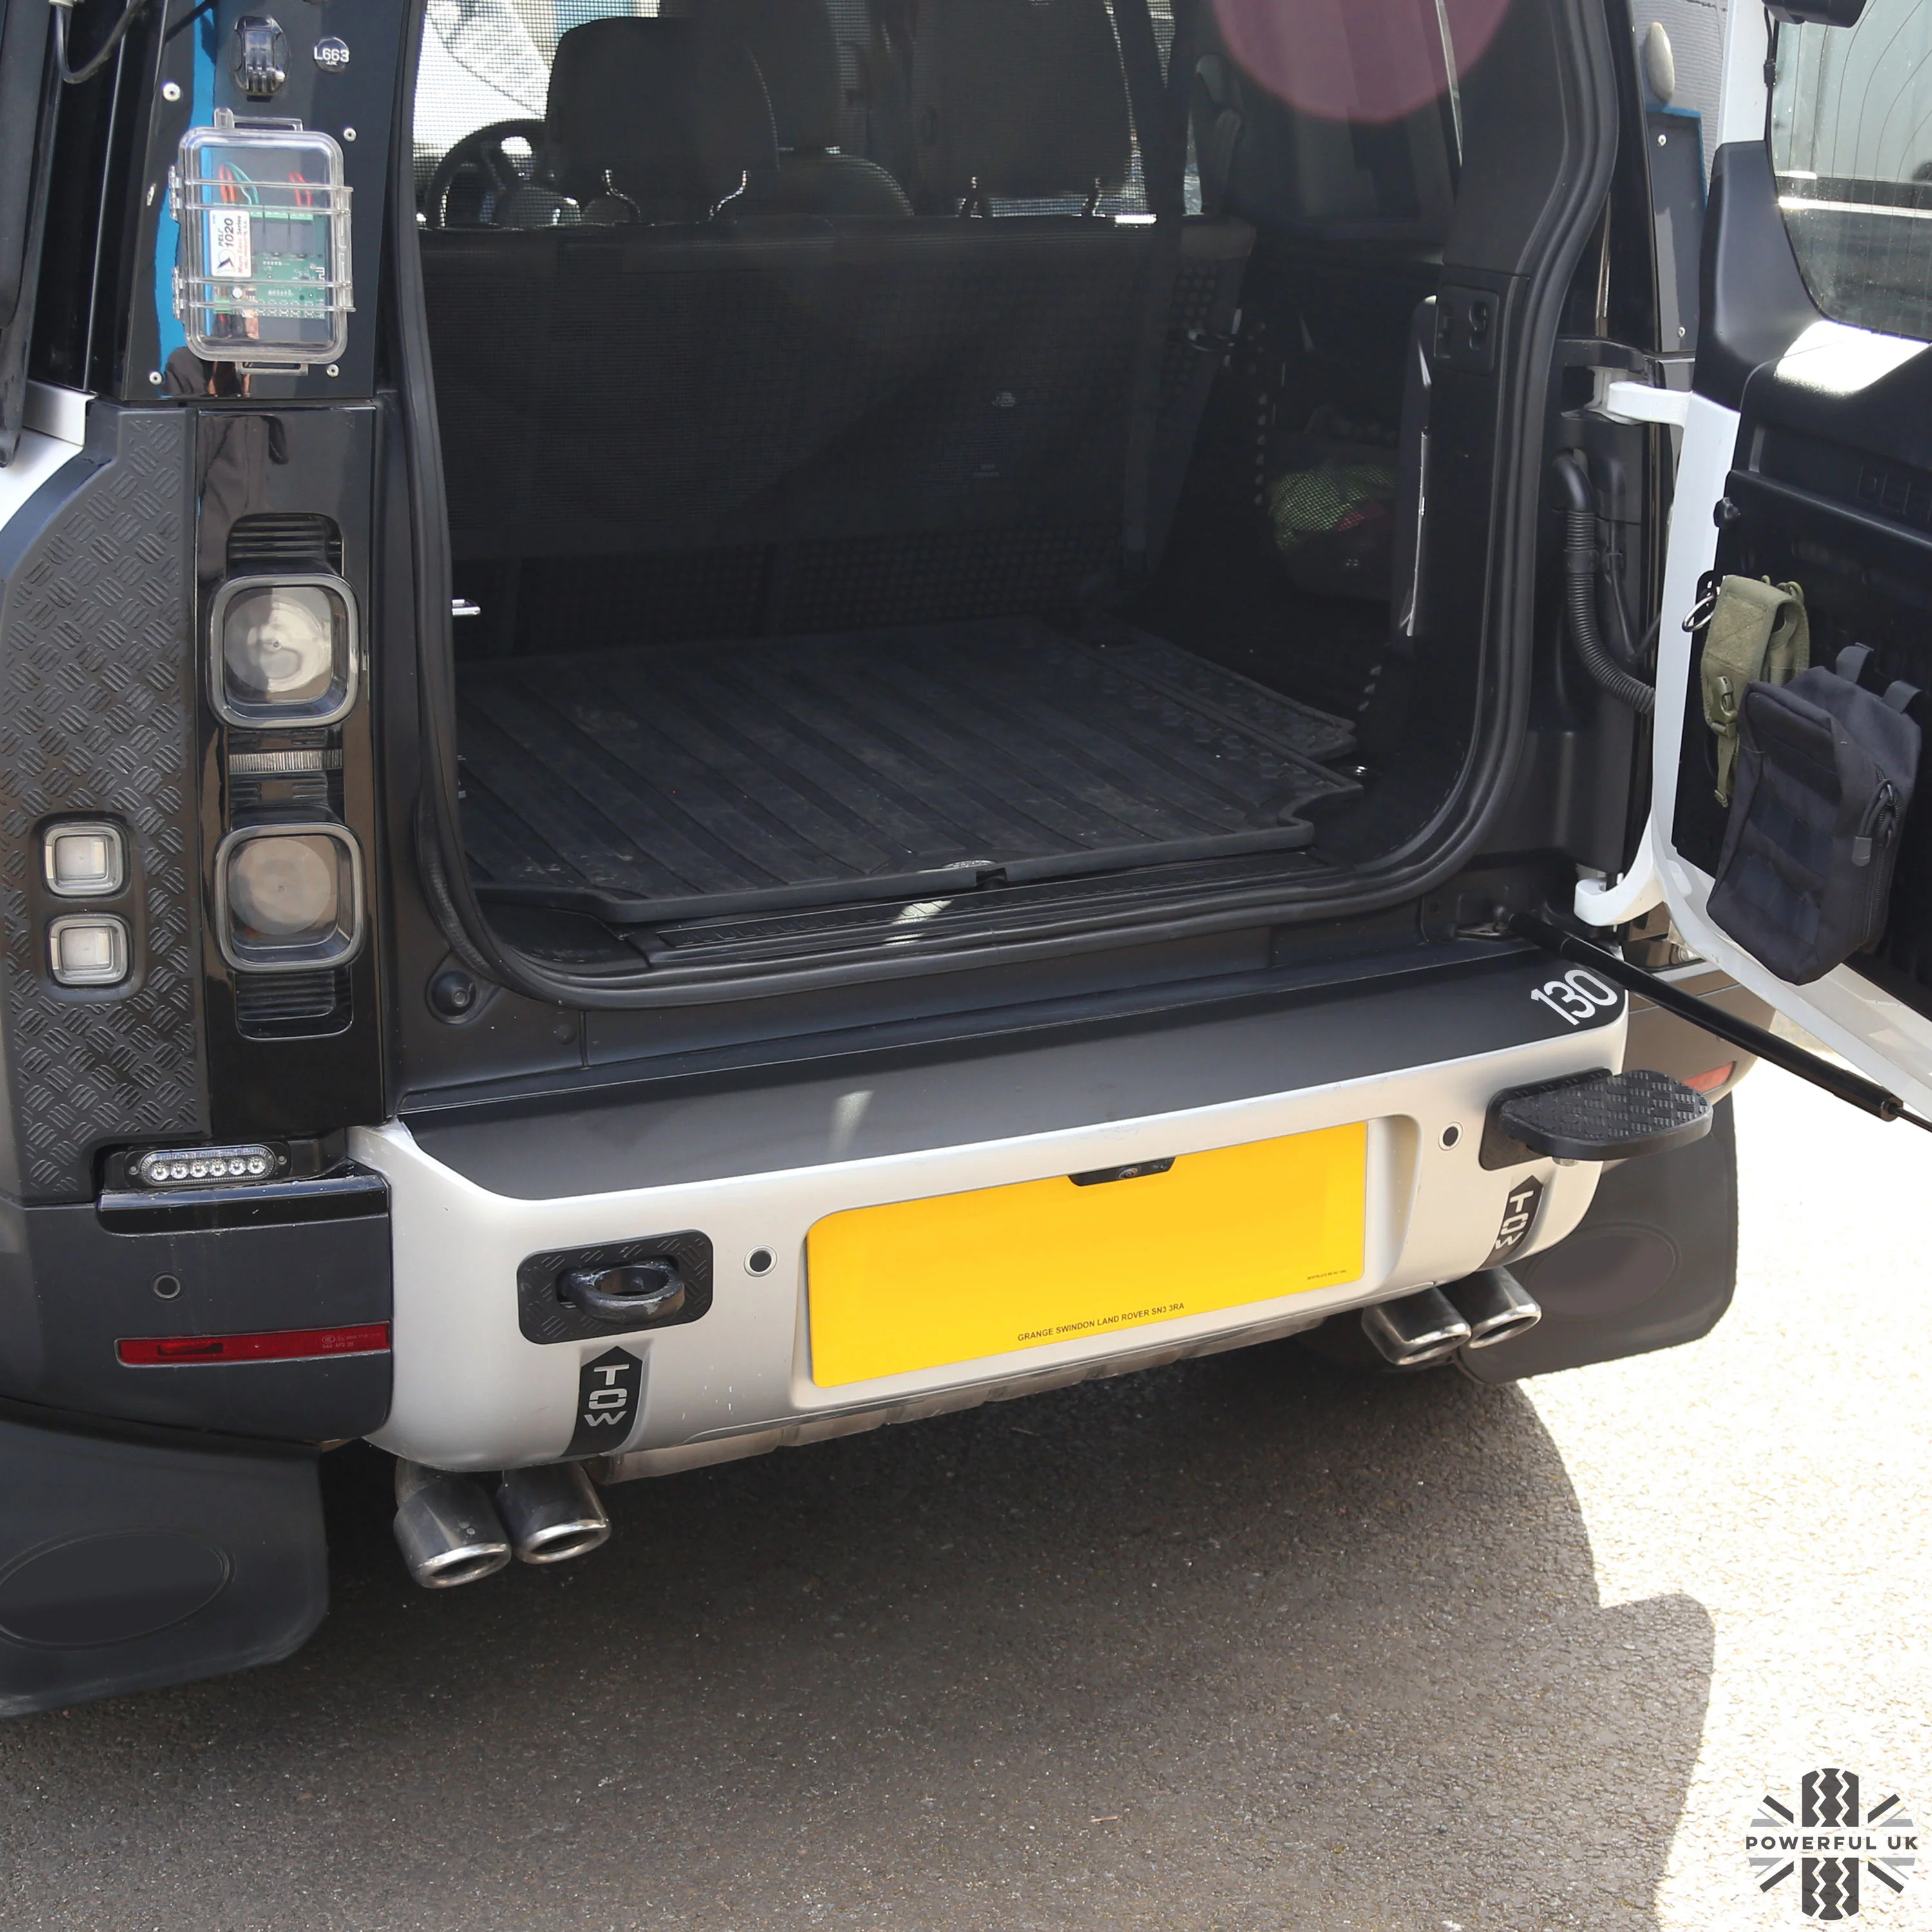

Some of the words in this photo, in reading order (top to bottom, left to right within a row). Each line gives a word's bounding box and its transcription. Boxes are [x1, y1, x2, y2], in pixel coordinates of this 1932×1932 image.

[314, 46, 349, 62] L663
[224, 218, 234, 248] 1020
[1531, 969, 1618, 1025] 130
[1495, 1190, 1534, 1249] TOW
[1018, 1328, 1054, 1341] GRANGE
[1056, 1321, 1095, 1334] SWINDON
[1097, 1315, 1119, 1326] LAND
[1121, 1309, 1150, 1321] ROVER
[1151, 1305, 1167, 1314] SN3
[1169, 1303, 1184, 1312] 3RA
[584, 1363, 630, 1427] TOW
